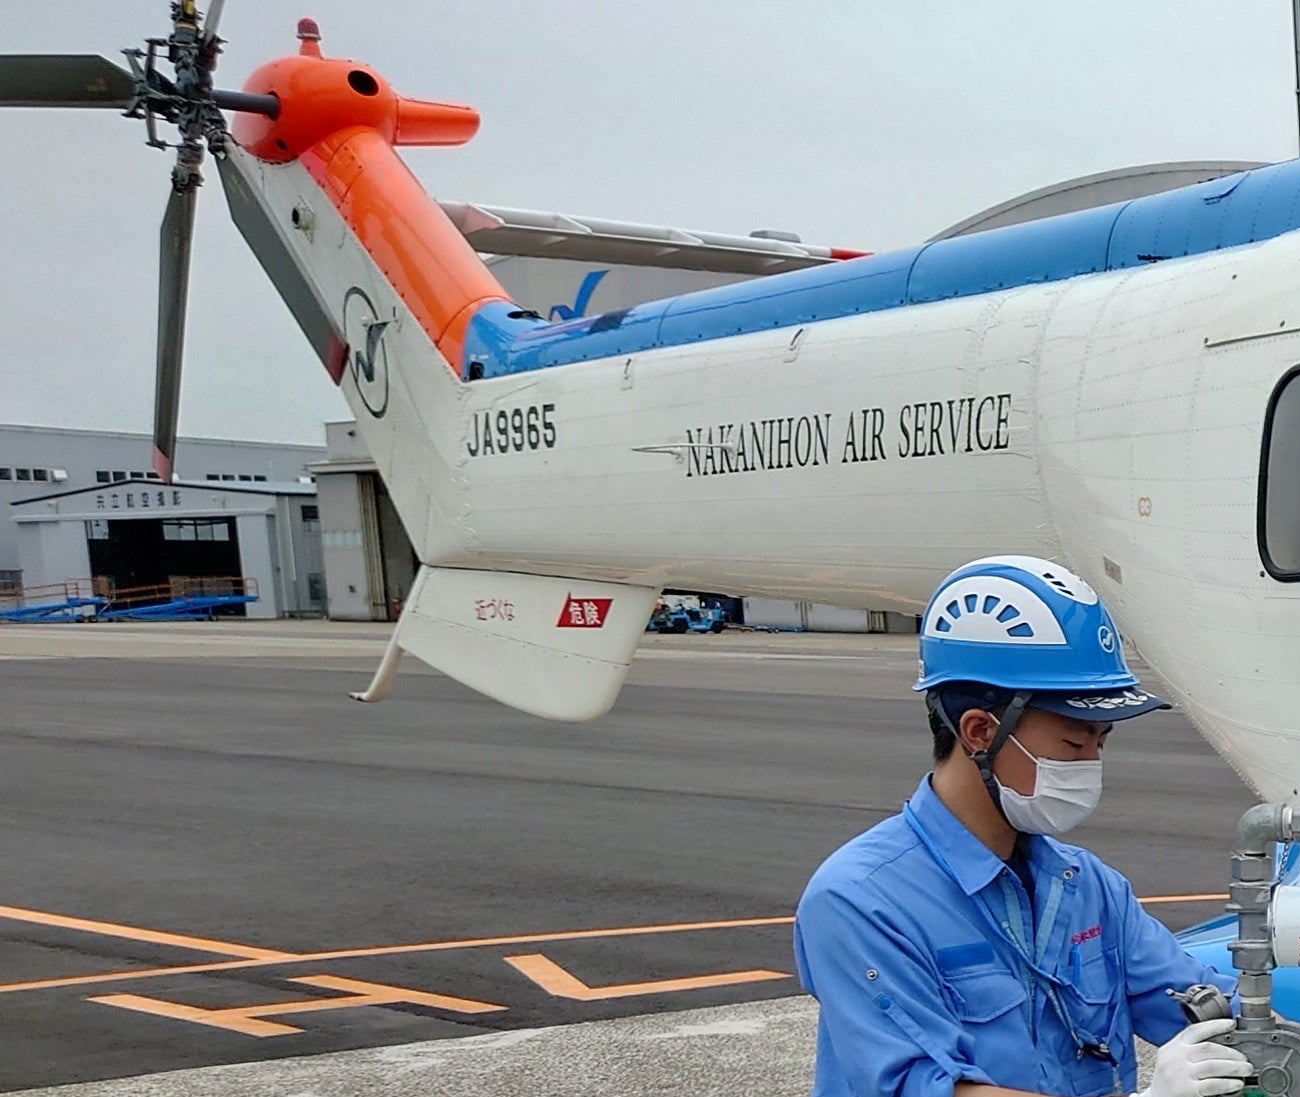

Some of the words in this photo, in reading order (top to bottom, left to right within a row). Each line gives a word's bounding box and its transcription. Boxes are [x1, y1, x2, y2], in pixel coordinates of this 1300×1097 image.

[467, 403, 556, 458] JA9965
[686, 413, 832, 478] NAKANIHON
[842, 408, 887, 464] AIR
[899, 393, 1012, 459] SERVICE
[568, 601, 602, 625] 危険
